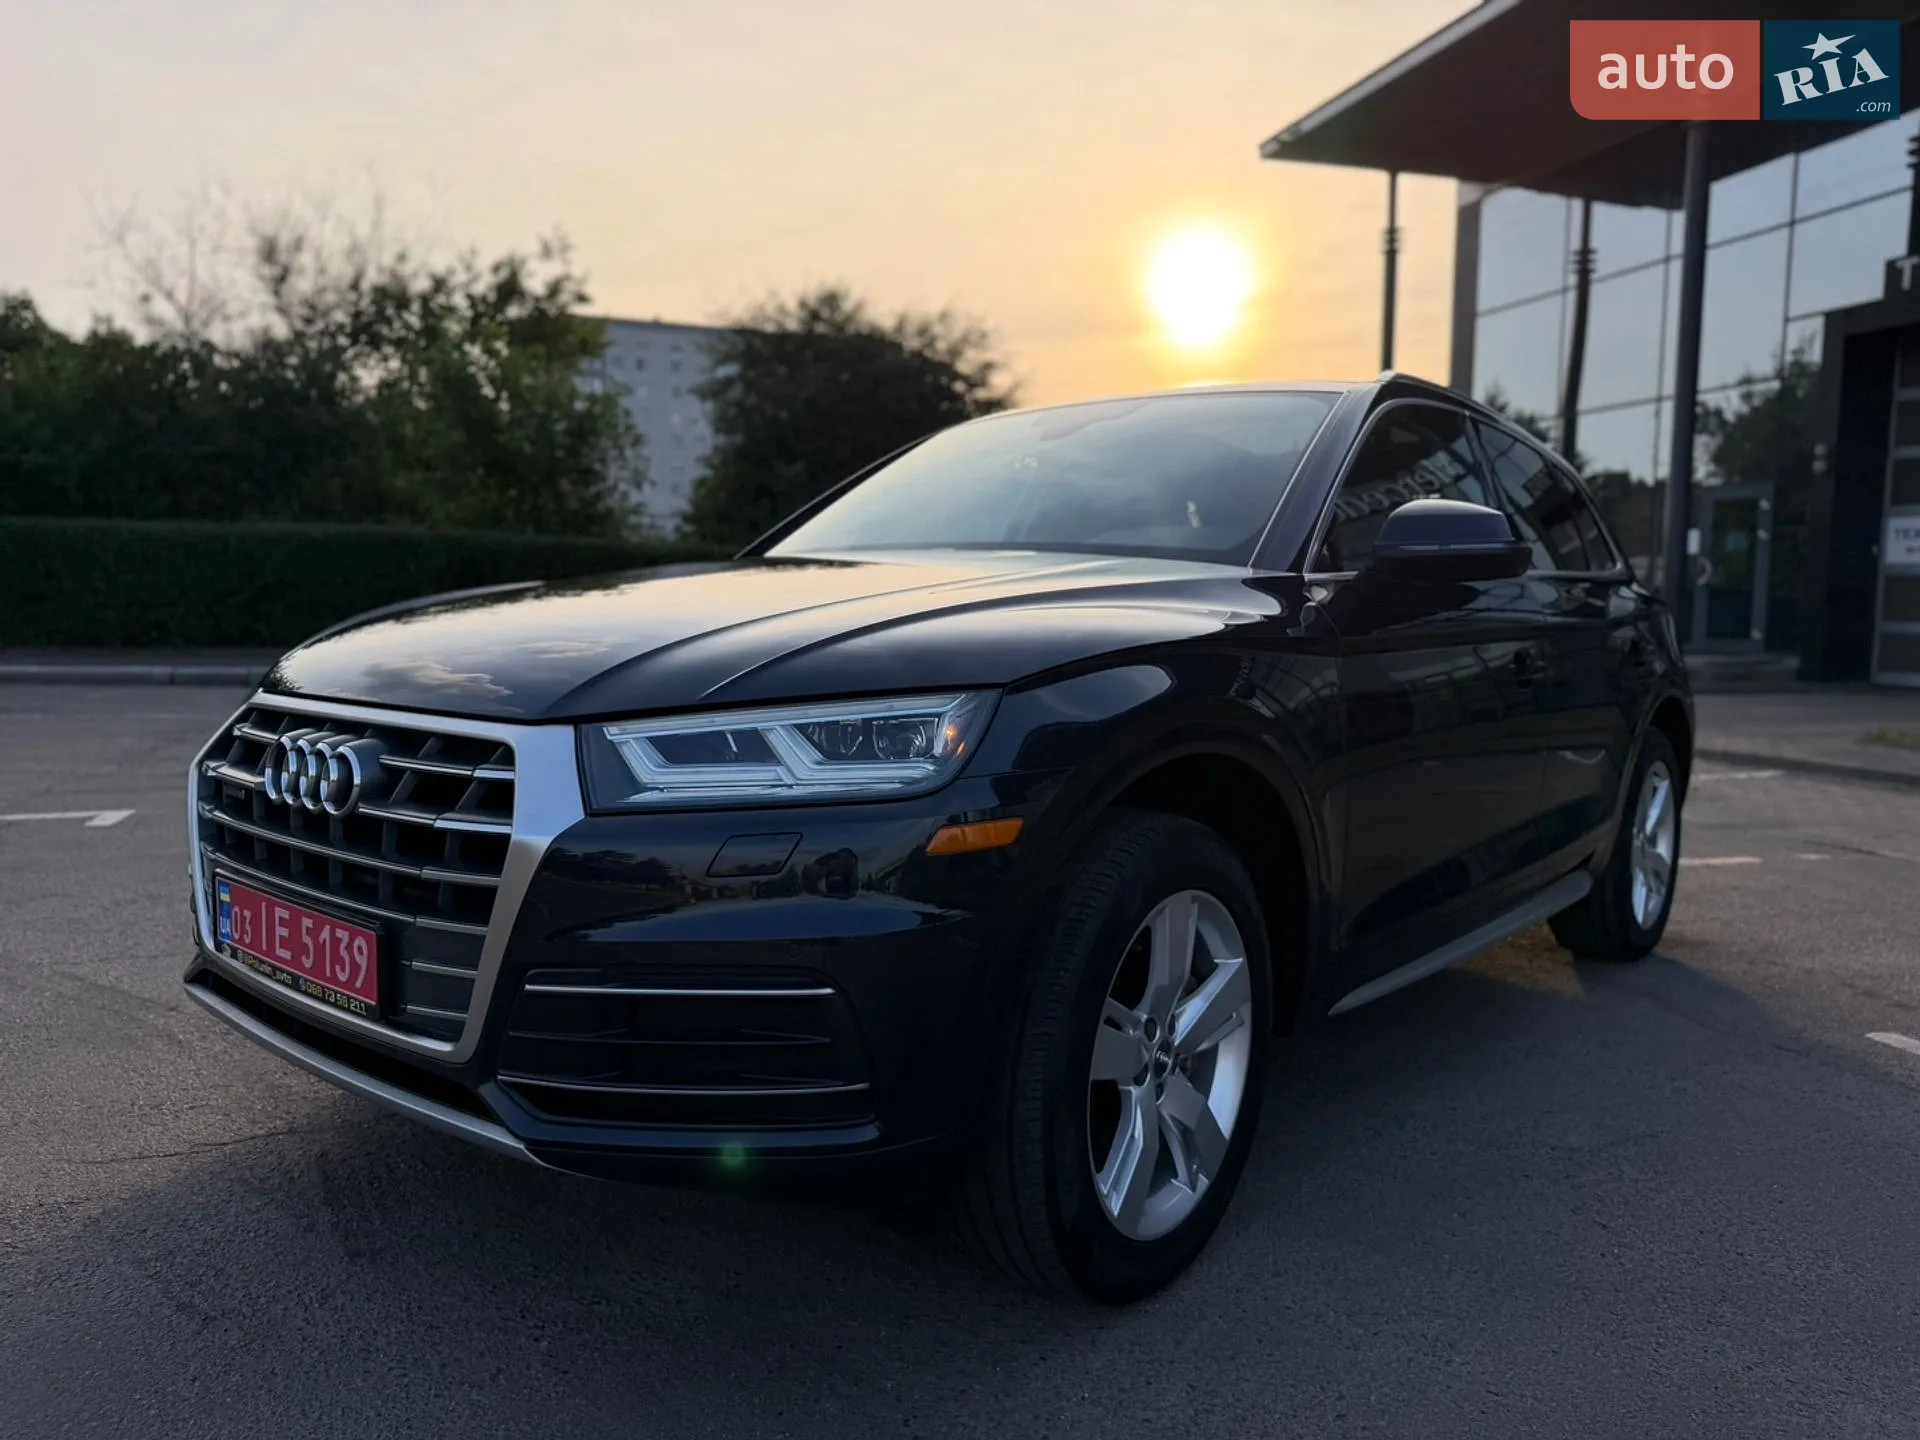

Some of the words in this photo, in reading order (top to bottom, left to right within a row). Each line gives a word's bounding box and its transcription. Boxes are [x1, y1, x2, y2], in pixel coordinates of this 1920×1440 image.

[231, 905, 252, 945] 03
[261, 901, 292, 961] IE
[301, 916, 369, 989] 5139
[349, 999, 367, 1016] 211
